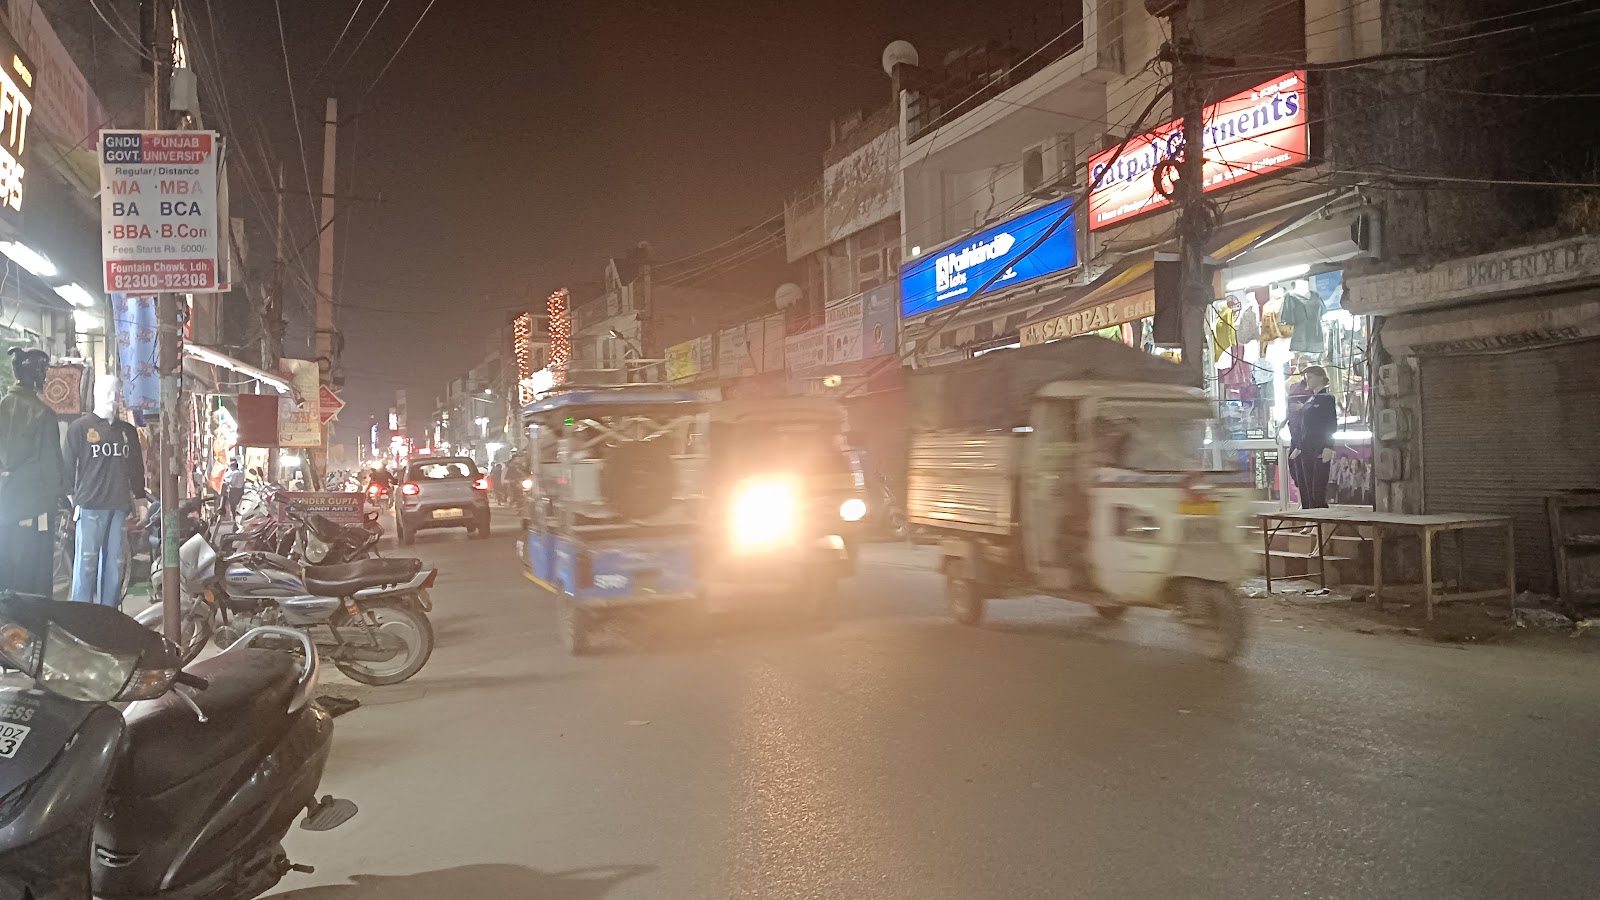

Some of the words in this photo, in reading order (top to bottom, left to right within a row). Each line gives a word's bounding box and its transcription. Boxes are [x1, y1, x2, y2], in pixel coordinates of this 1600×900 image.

[105, 137, 140, 148] GNDU
[153, 137, 199, 148] PUNJAB
[1093, 139, 1160, 190] Satpal
[1166, 91, 1299, 162] Grments
[106, 150, 140, 161] GOVT.
[143, 151, 208, 161] UNIVERSITY
[112, 180, 141, 195] MA
[160, 180, 204, 195] MBA
[112, 202, 140, 217] BA
[160, 201, 202, 217] BCA
[113, 224, 152, 239] BBA
[112, 245, 134, 254] Fees
[136, 244, 162, 254] Starts
[111, 263, 151, 273] Fountain
[115, 273, 207, 288] 82300-82308
[1043, 302, 1119, 340] SATPAL
[91, 442, 130, 458] POLO
